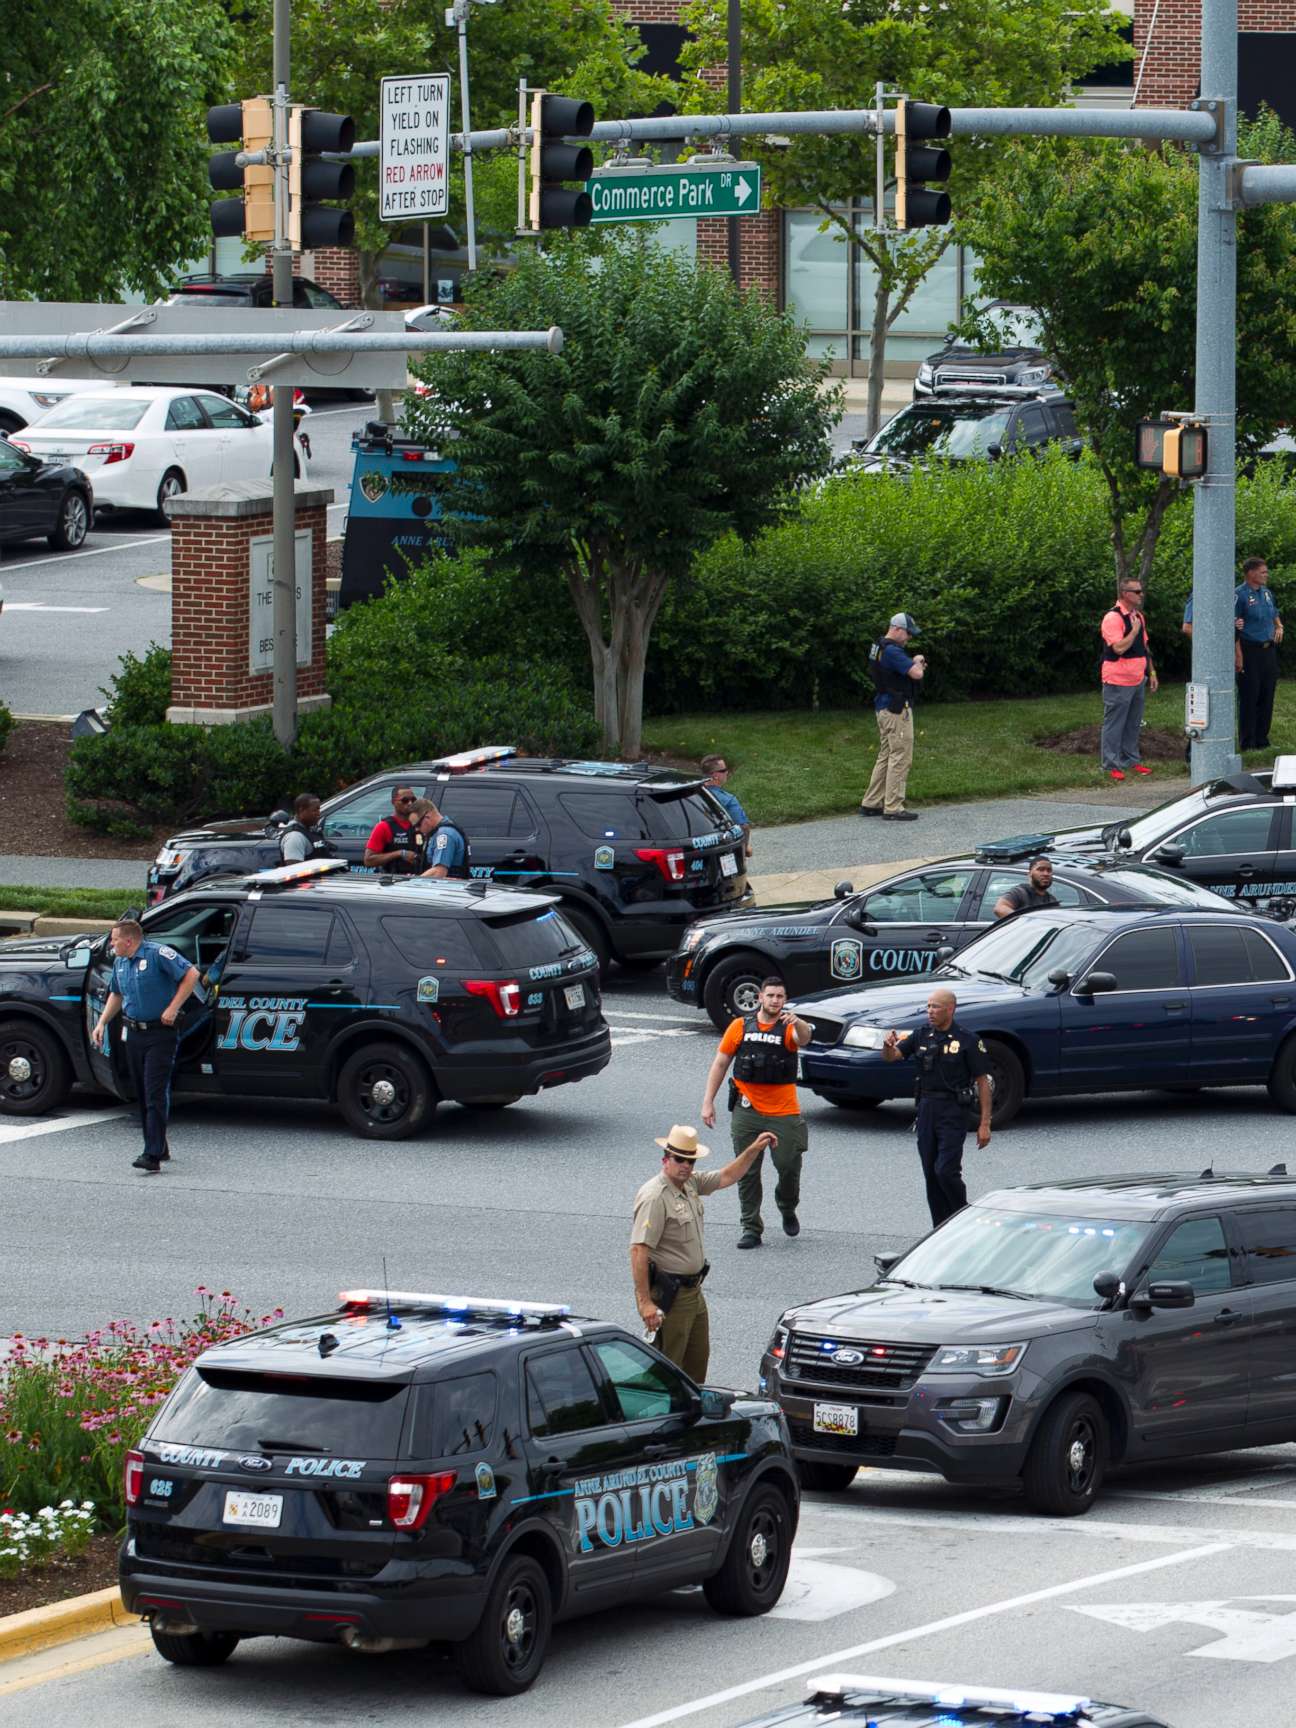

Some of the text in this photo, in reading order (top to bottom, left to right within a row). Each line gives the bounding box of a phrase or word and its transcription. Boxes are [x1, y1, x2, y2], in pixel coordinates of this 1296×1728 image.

[388, 84, 443, 104] LEFT TURN
[392, 111, 439, 130] YIELD ON
[391, 137, 439, 156] FLASHING
[386, 163, 444, 183] RED ARROW
[385, 189, 444, 210] AFTER STOP
[591, 173, 732, 211] Commerce Park DR
[391, 536, 423, 545] ANNE
[257, 591, 273, 606] THE
[692, 834, 720, 848] COUNTY
[1207, 885, 1237, 897] NNE
[769, 927, 817, 936] ARUNDEL
[870, 949, 938, 971] COUNT
[529, 963, 563, 979] COUNTY
[249, 997, 308, 1010] COUNTY
[744, 1032, 782, 1045] POLICE
[160, 1446, 230, 1468] COUNTY
[284, 1458, 367, 1478] POLICE
[150, 1479, 173, 1497] 625
[575, 1460, 687, 1497] ANNE ARUNDEL COUNTY
[575, 1477, 694, 1553] POLICE
